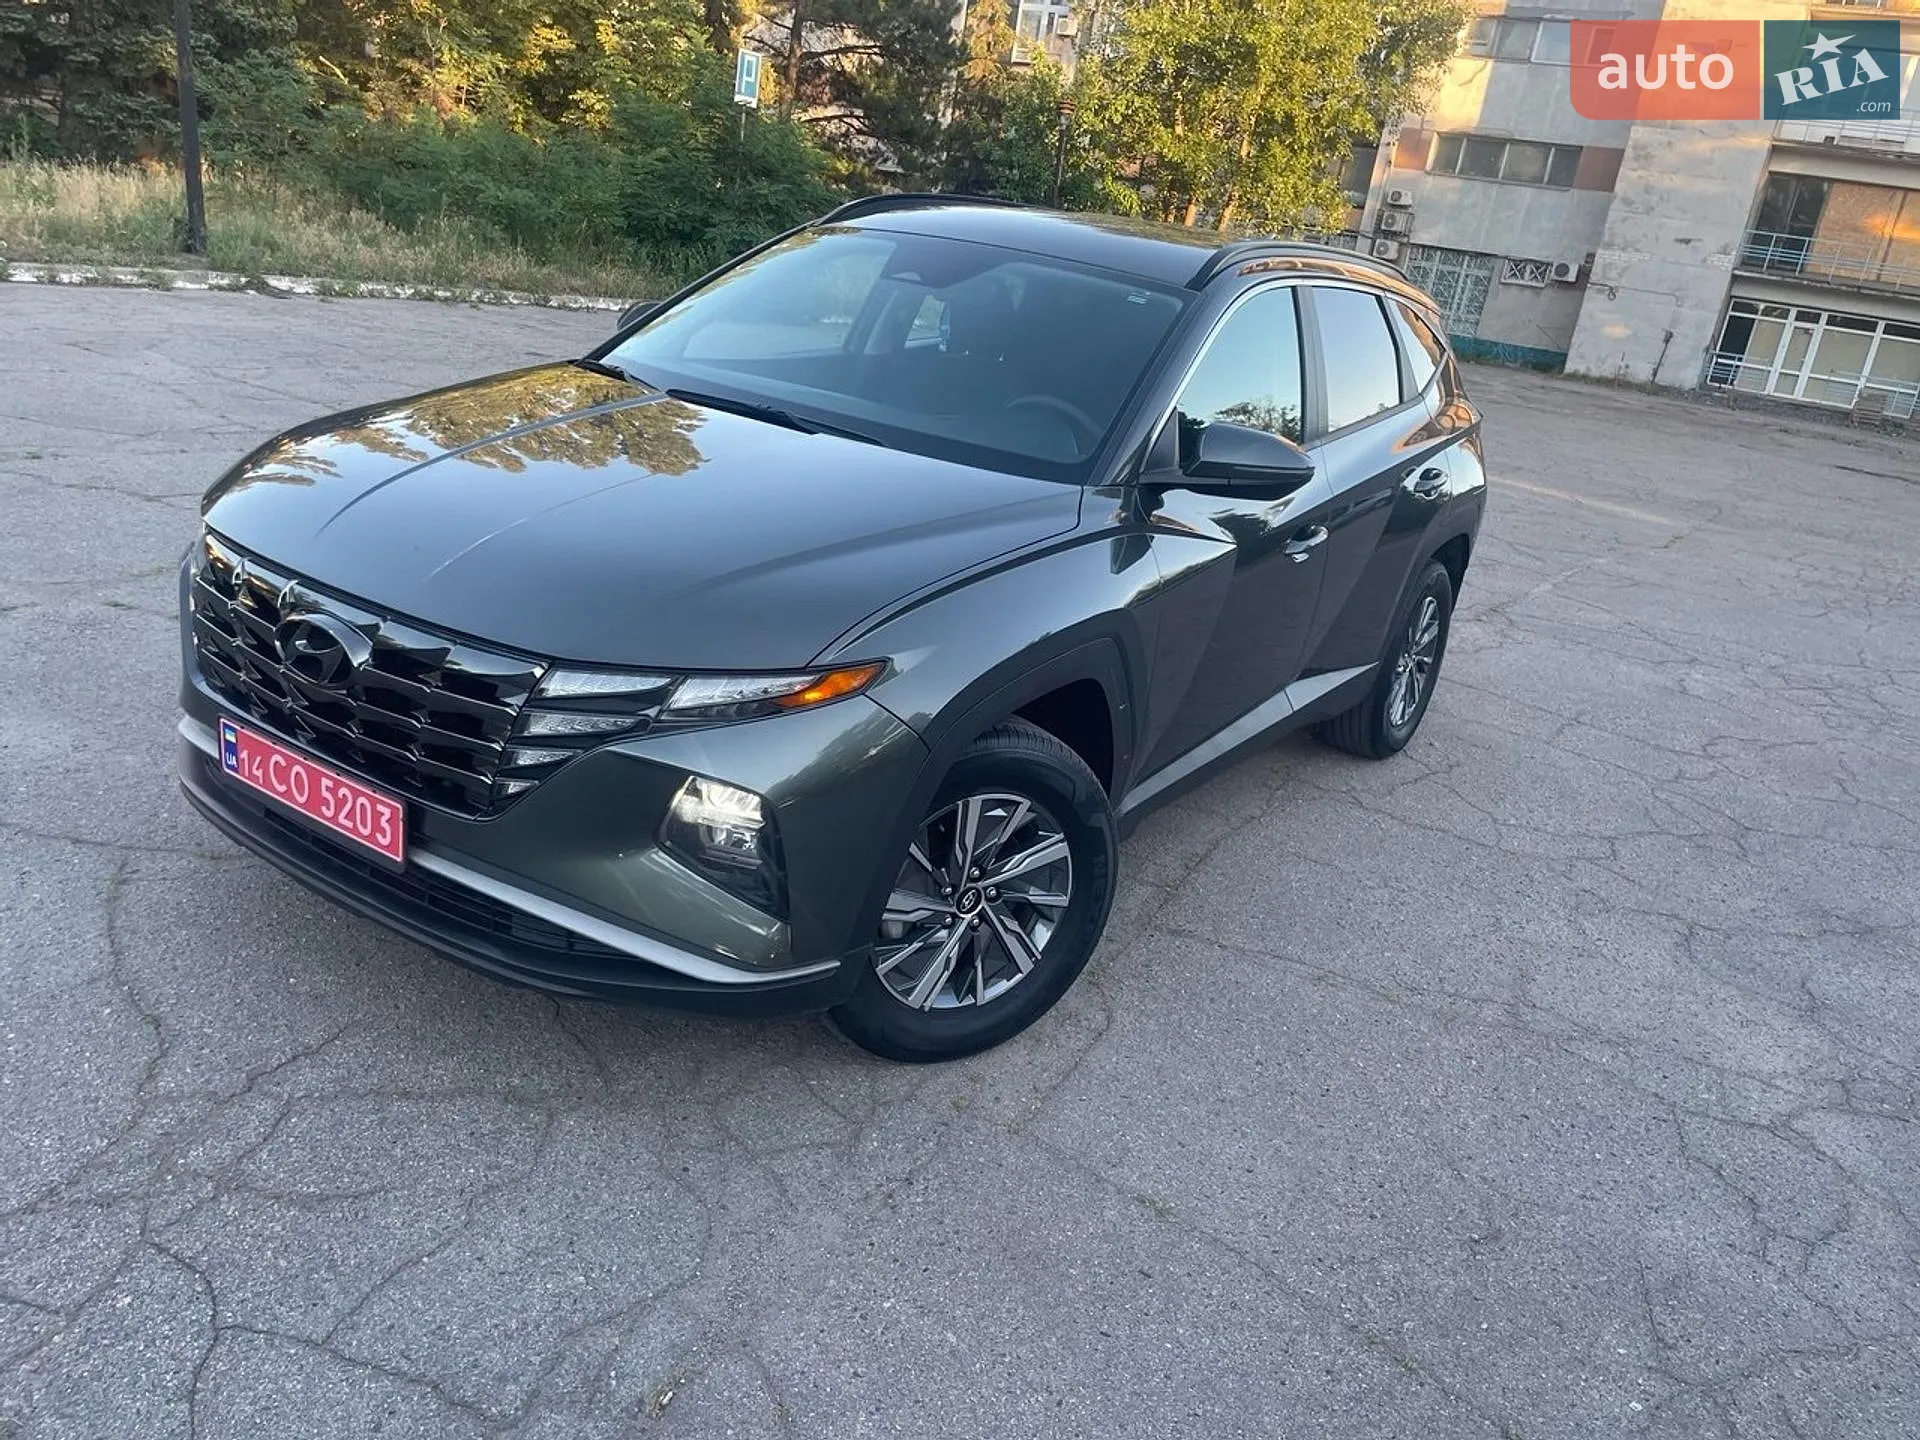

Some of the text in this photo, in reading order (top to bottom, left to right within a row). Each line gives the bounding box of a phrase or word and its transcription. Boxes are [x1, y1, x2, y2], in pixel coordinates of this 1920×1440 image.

[742, 54, 756, 94] P
[226, 752, 238, 768] UA
[240, 750, 392, 846] 14CO 5203
